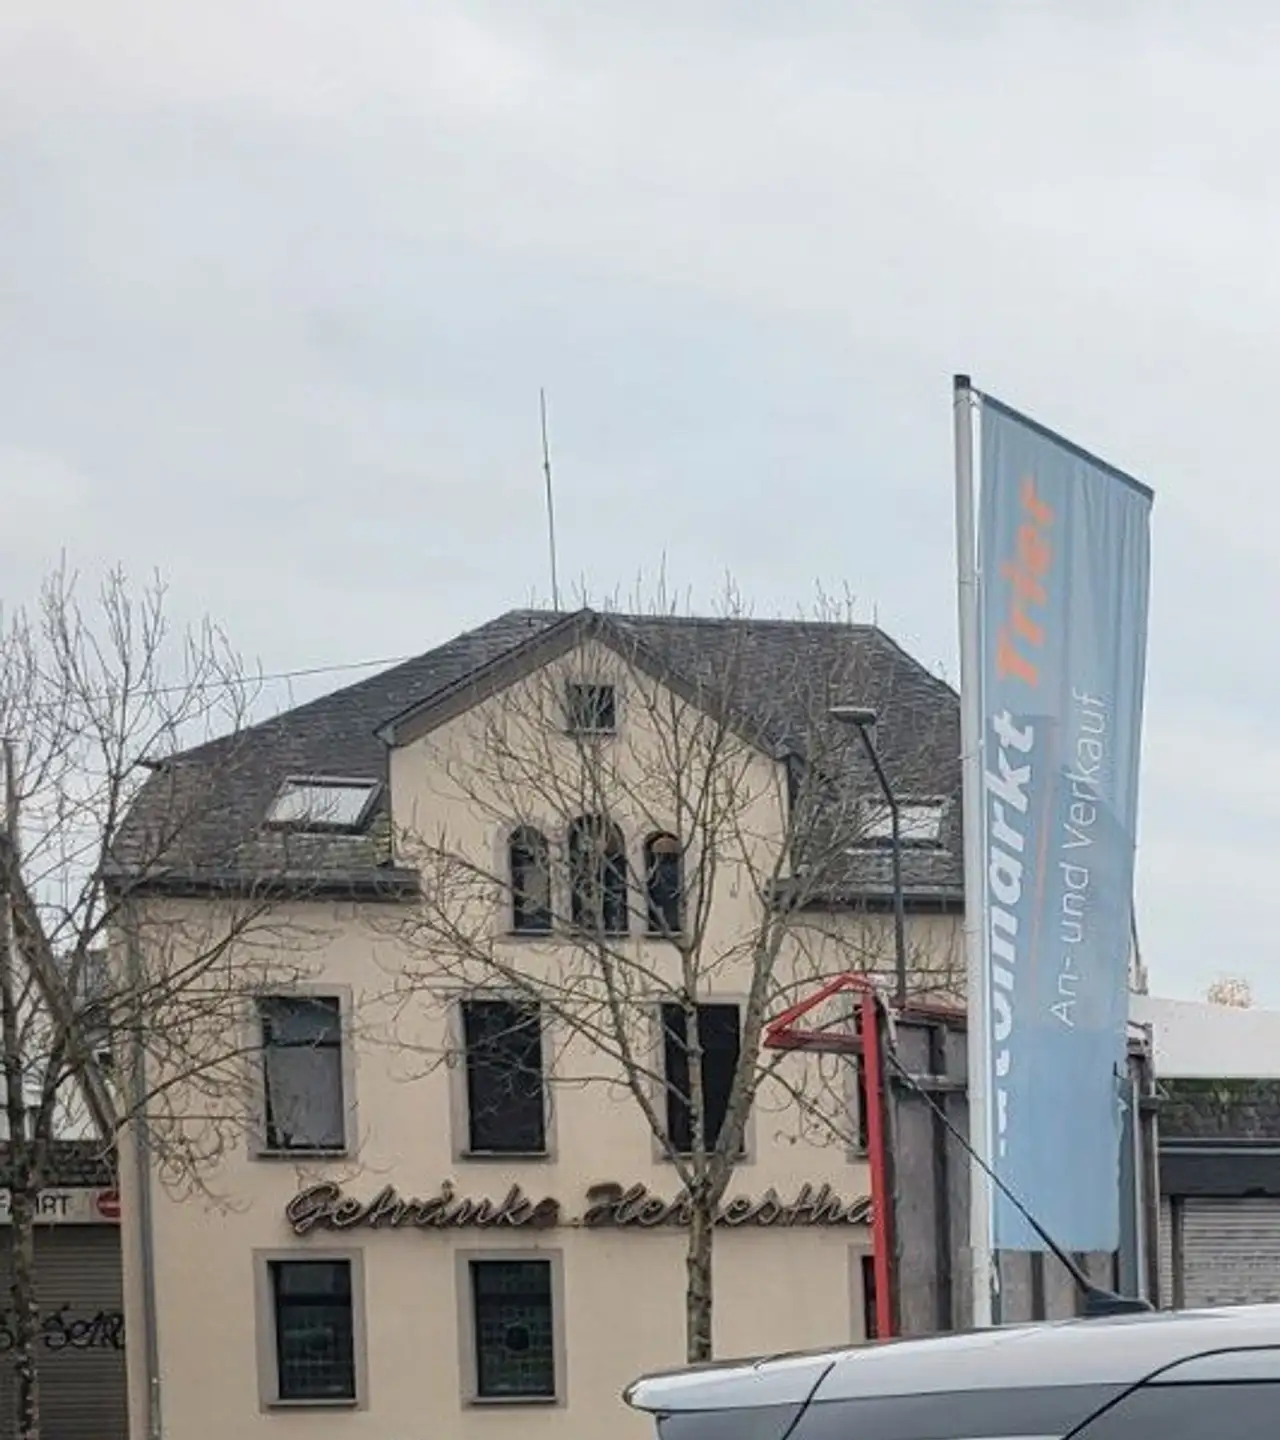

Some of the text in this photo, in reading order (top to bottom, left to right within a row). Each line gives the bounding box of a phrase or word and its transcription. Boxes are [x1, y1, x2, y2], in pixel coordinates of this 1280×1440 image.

[996, 475, 1054, 688] Trier
[1050, 690, 1109, 1028] An- und Verkauf
